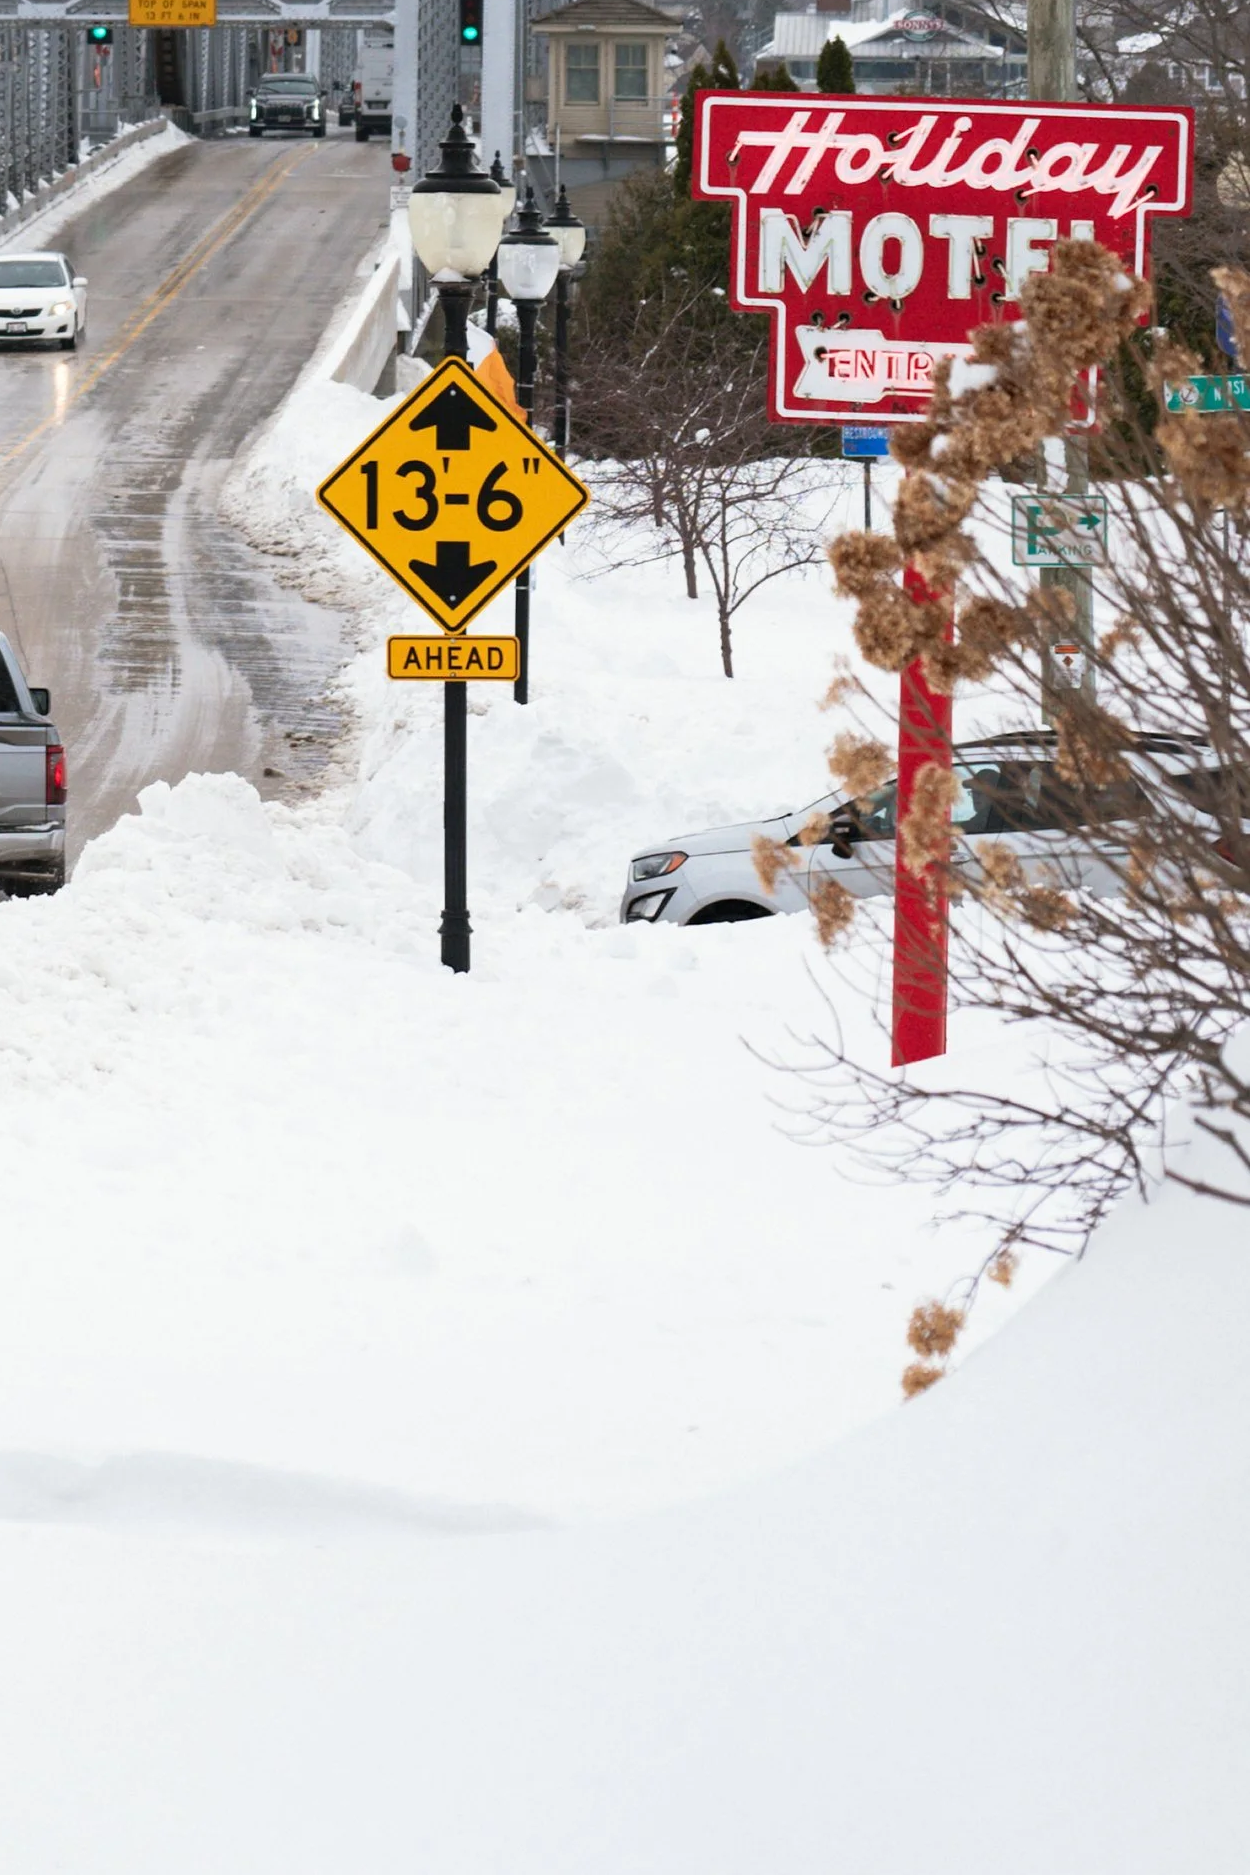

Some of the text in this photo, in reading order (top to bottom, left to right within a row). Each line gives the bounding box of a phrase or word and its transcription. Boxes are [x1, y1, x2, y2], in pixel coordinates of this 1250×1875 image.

[138, 0, 207, 9] TOP OF SPAN
[145, 11, 156, 20] 13
[161, 11, 172, 20] FT
[189, 12, 200, 21] IN
[730, 111, 1163, 219] Holiday
[758, 207, 1094, 301] MOTE
[1214, 386, 1222, 401] N
[360, 457, 540, 532] 13'-6"
[403, 646, 504, 671] AHEAD
